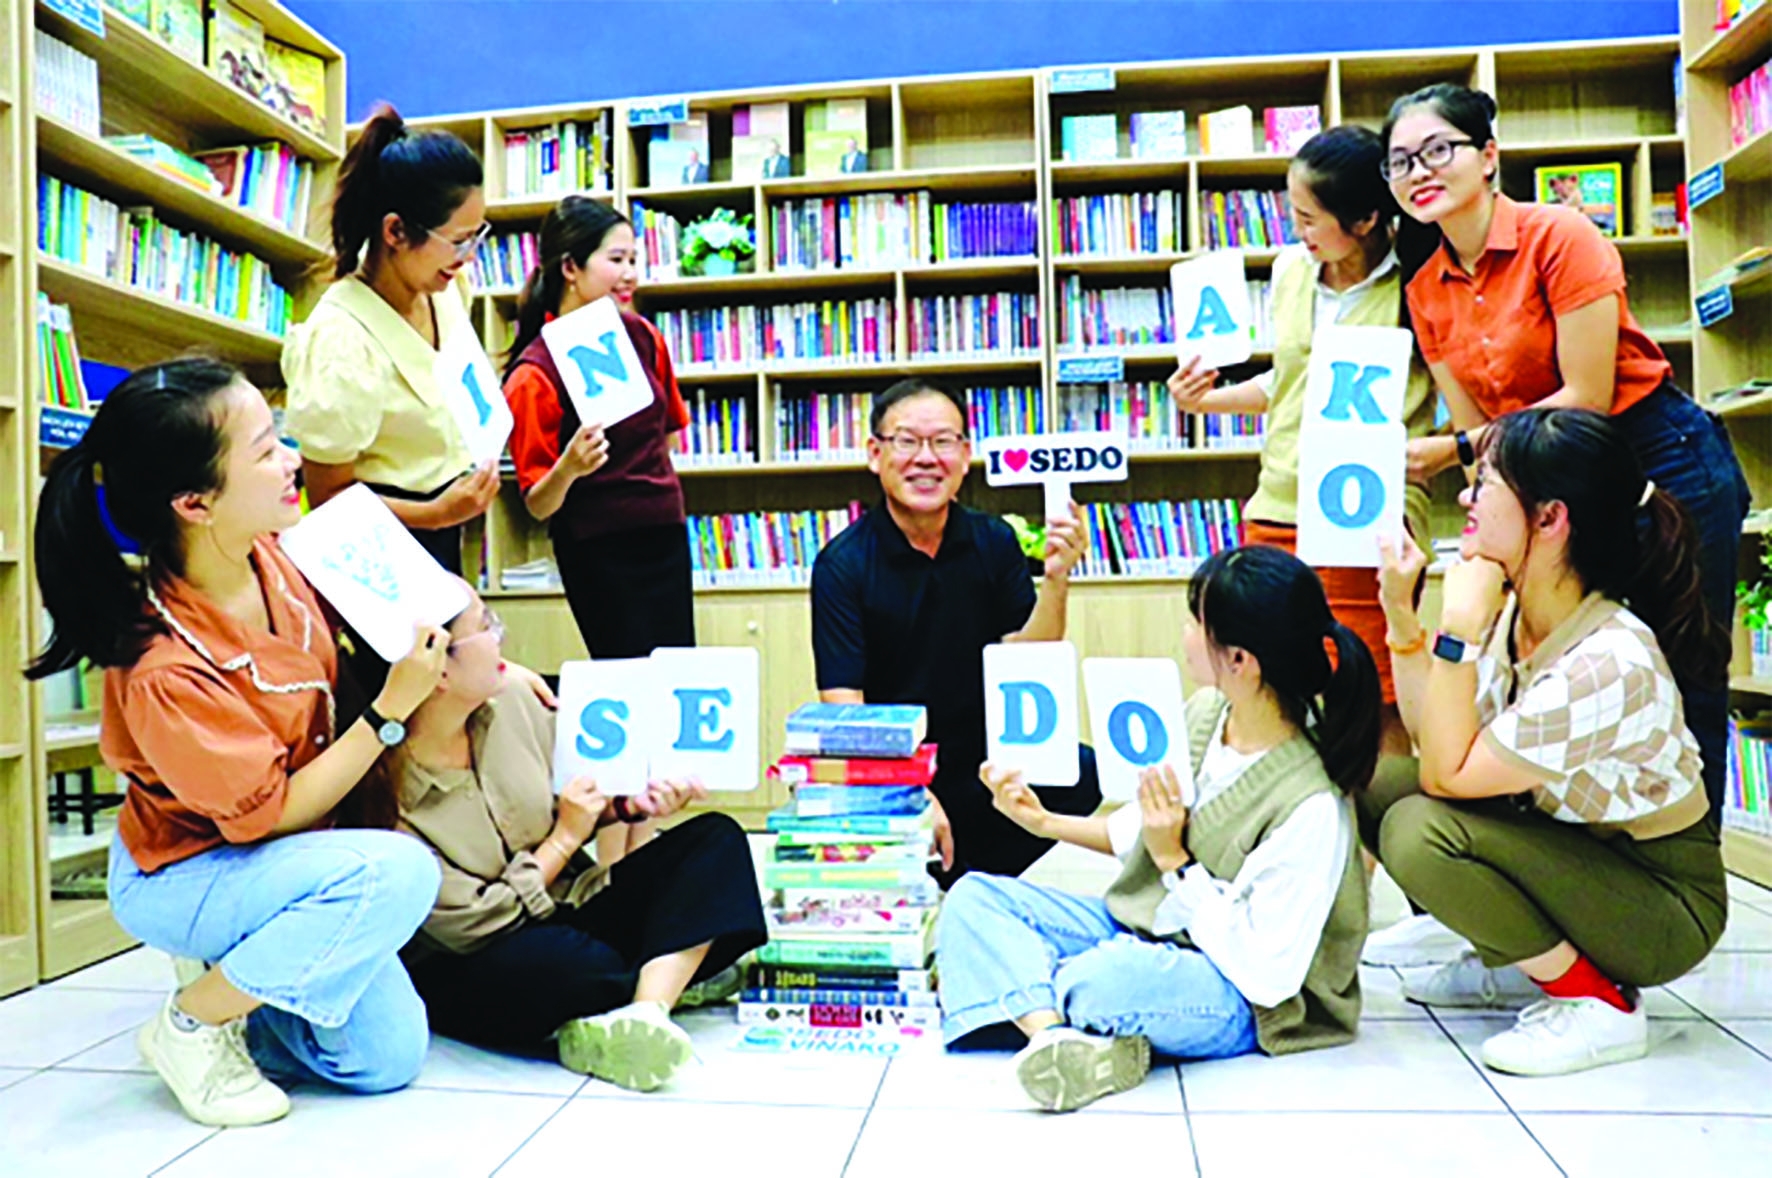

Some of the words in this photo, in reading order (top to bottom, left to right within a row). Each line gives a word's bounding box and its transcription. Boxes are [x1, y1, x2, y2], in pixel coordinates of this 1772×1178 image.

[1187, 285, 1237, 339] A
[462, 362, 492, 427] I
[567, 330, 630, 398] N
[1320, 361, 1391, 424] K
[988, 450, 1002, 475] I
[1029, 446, 1123, 473] SEDO
[1318, 463, 1386, 530] O
[575, 698, 630, 761] S
[672, 687, 735, 753] E
[998, 681, 1058, 746] D
[1107, 700, 1169, 767] O
